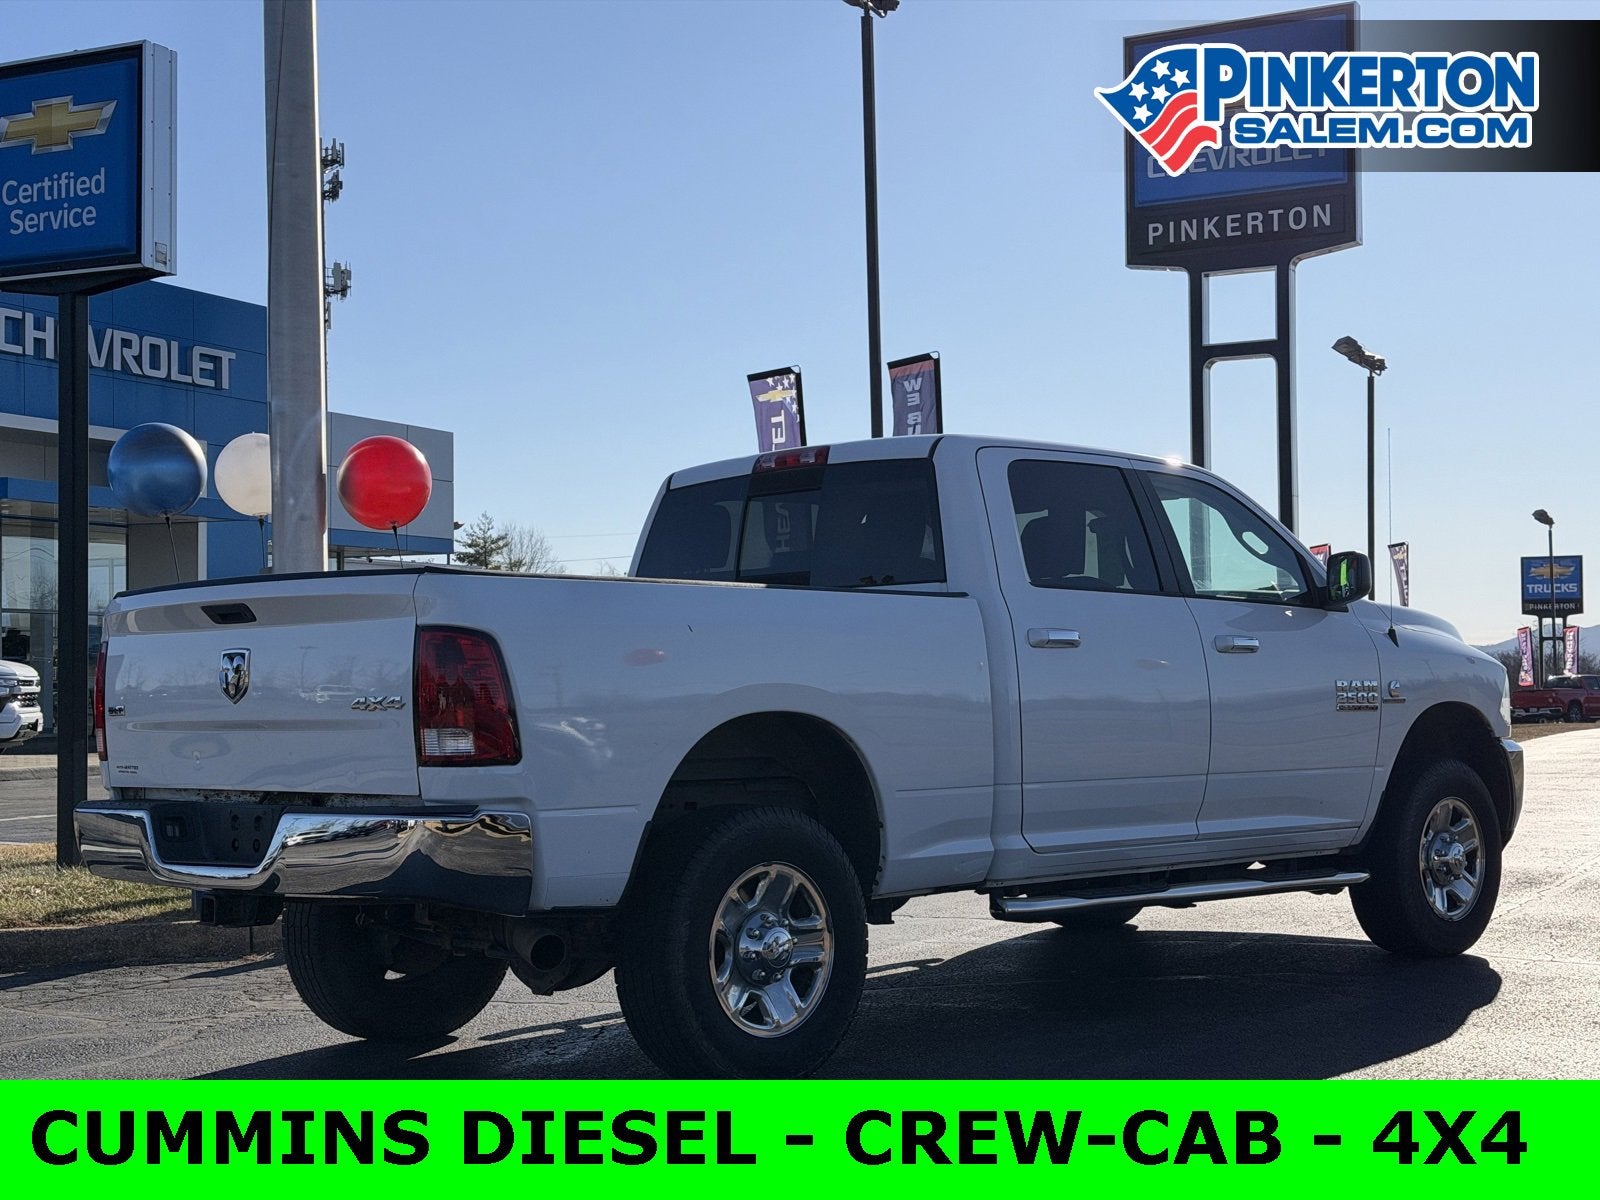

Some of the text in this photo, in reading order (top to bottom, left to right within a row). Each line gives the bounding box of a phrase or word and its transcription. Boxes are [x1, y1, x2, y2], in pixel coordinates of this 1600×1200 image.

[1, 167, 106, 206] Certified
[9, 202, 97, 236] Service
[1148, 203, 1331, 246] PINKERTON
[0, 306, 237, 390] CHVROLET
[1526, 583, 1578, 593] TRUCKS
[1336, 680, 1378, 692] RAM
[1336, 692, 1378, 704] 2500
